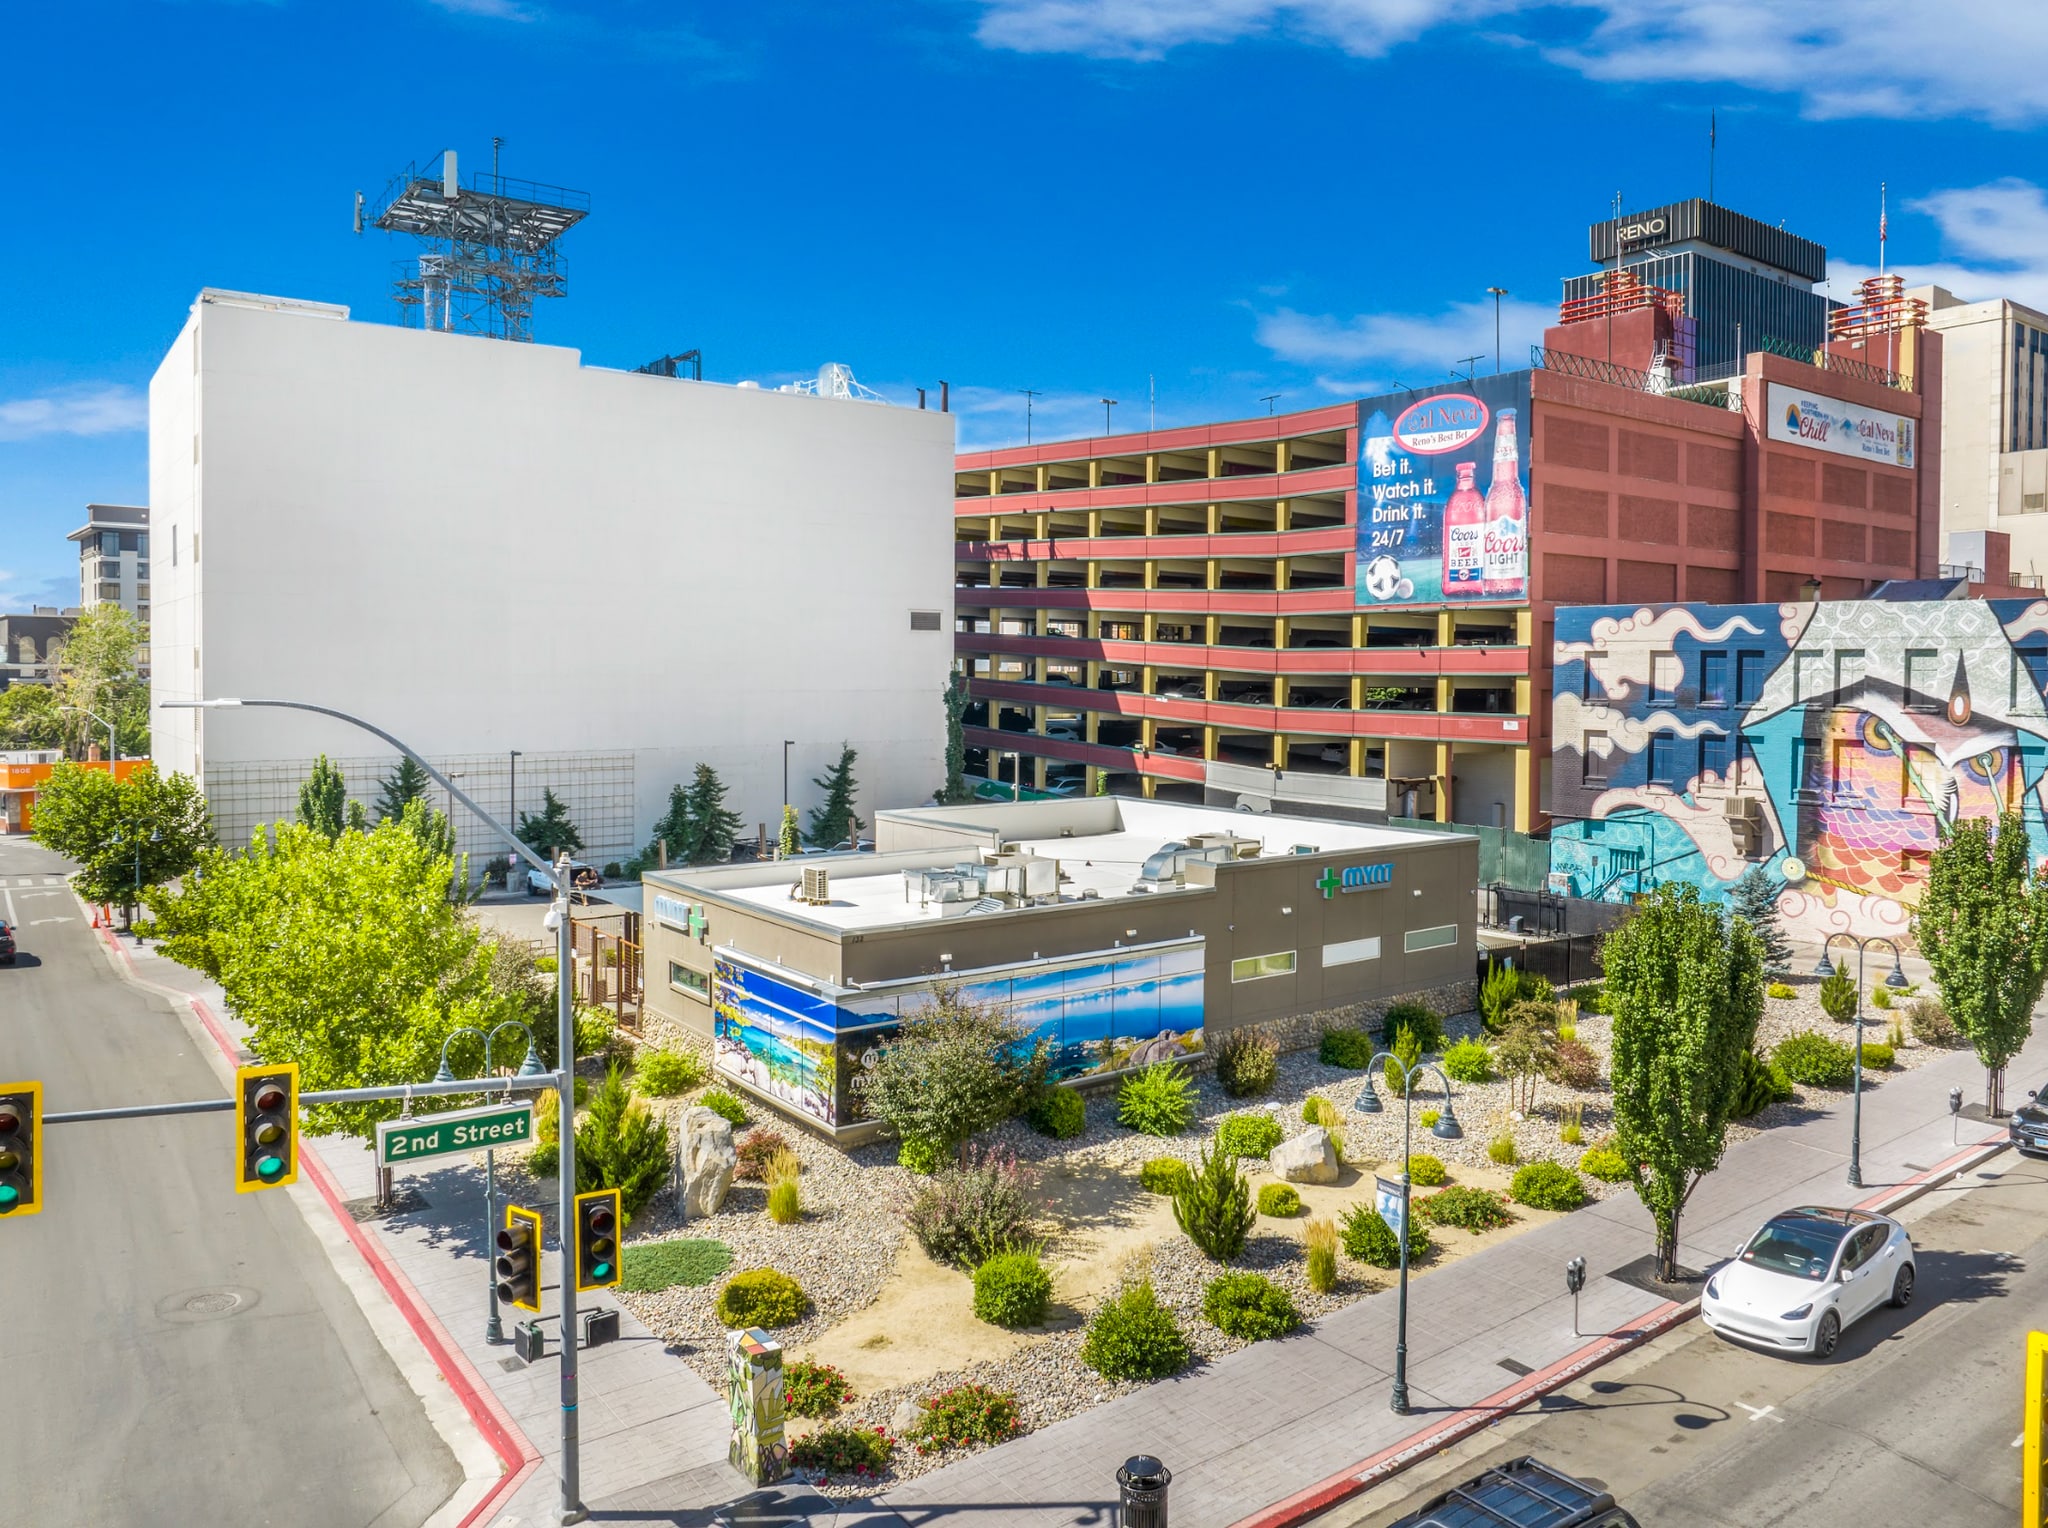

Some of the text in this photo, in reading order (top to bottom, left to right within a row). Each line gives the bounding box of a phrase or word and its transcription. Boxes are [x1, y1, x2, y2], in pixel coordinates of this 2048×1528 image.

[1617, 218, 1664, 241] RENO
[1439, 405, 1479, 427] Neva
[1412, 430, 1469, 447] Reno's Best Bet
[1799, 416, 1831, 442] Chill
[1875, 422, 1895, 443] Neva
[1373, 458, 1413, 478] Bet it.
[1372, 479, 1437, 499] Watch it.
[1372, 504, 1427, 524] Drink it.
[1371, 529, 1404, 547] 24/7
[1450, 527, 1479, 542] Coors
[1484, 530, 1525, 554] Coors
[1450, 558, 1479, 568] BEER
[1489, 553, 1519, 566] LIGHT
[391, 1117, 526, 1156] 2nd Street
